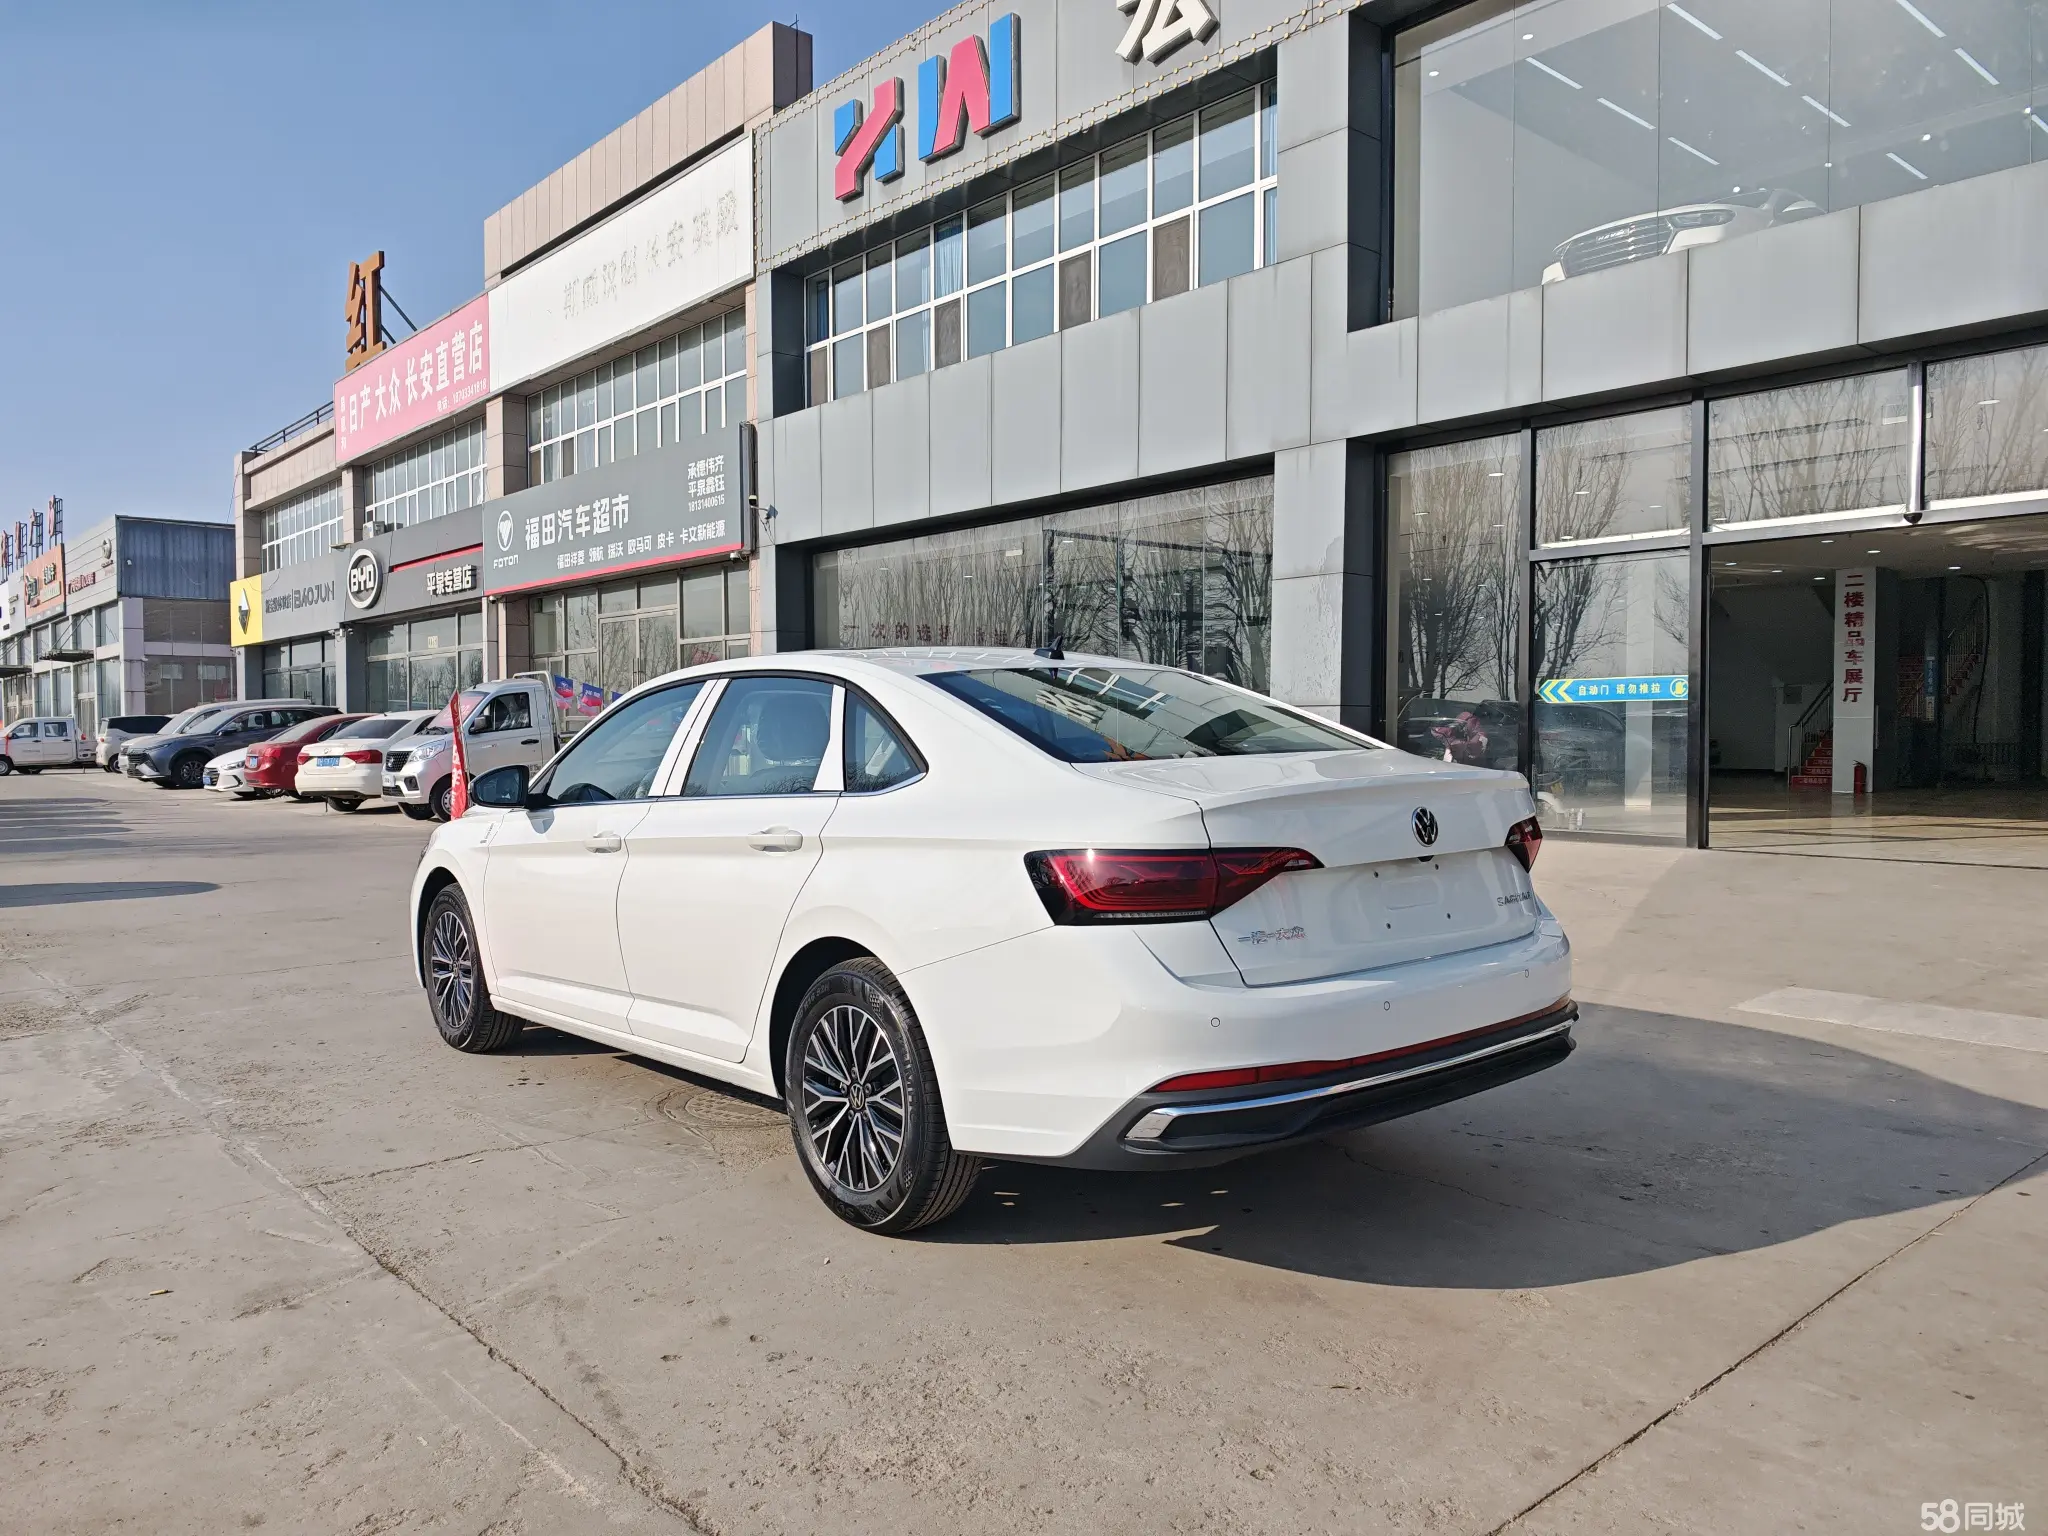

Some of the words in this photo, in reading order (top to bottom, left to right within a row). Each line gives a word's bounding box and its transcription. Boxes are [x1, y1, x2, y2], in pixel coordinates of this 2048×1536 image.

[350, 367, 401, 434] 日产大众
[405, 320, 483, 408] 长安直营店
[688, 454, 725, 480] 承德伟齐
[525, 493, 630, 550] 福田汽车超市
[627, 535, 652, 555] 欧马可
[657, 531, 675, 549] 皮卡
[493, 554, 519, 569] FOTON
[350, 564, 375, 593] BYD
[426, 564, 476, 596] 平泉专营店
[1843, 574, 1865, 703] 二楼精品车展厅
[1578, 684, 1610, 696] 自动门
[1616, 683, 1661, 695] 请勿推拉
